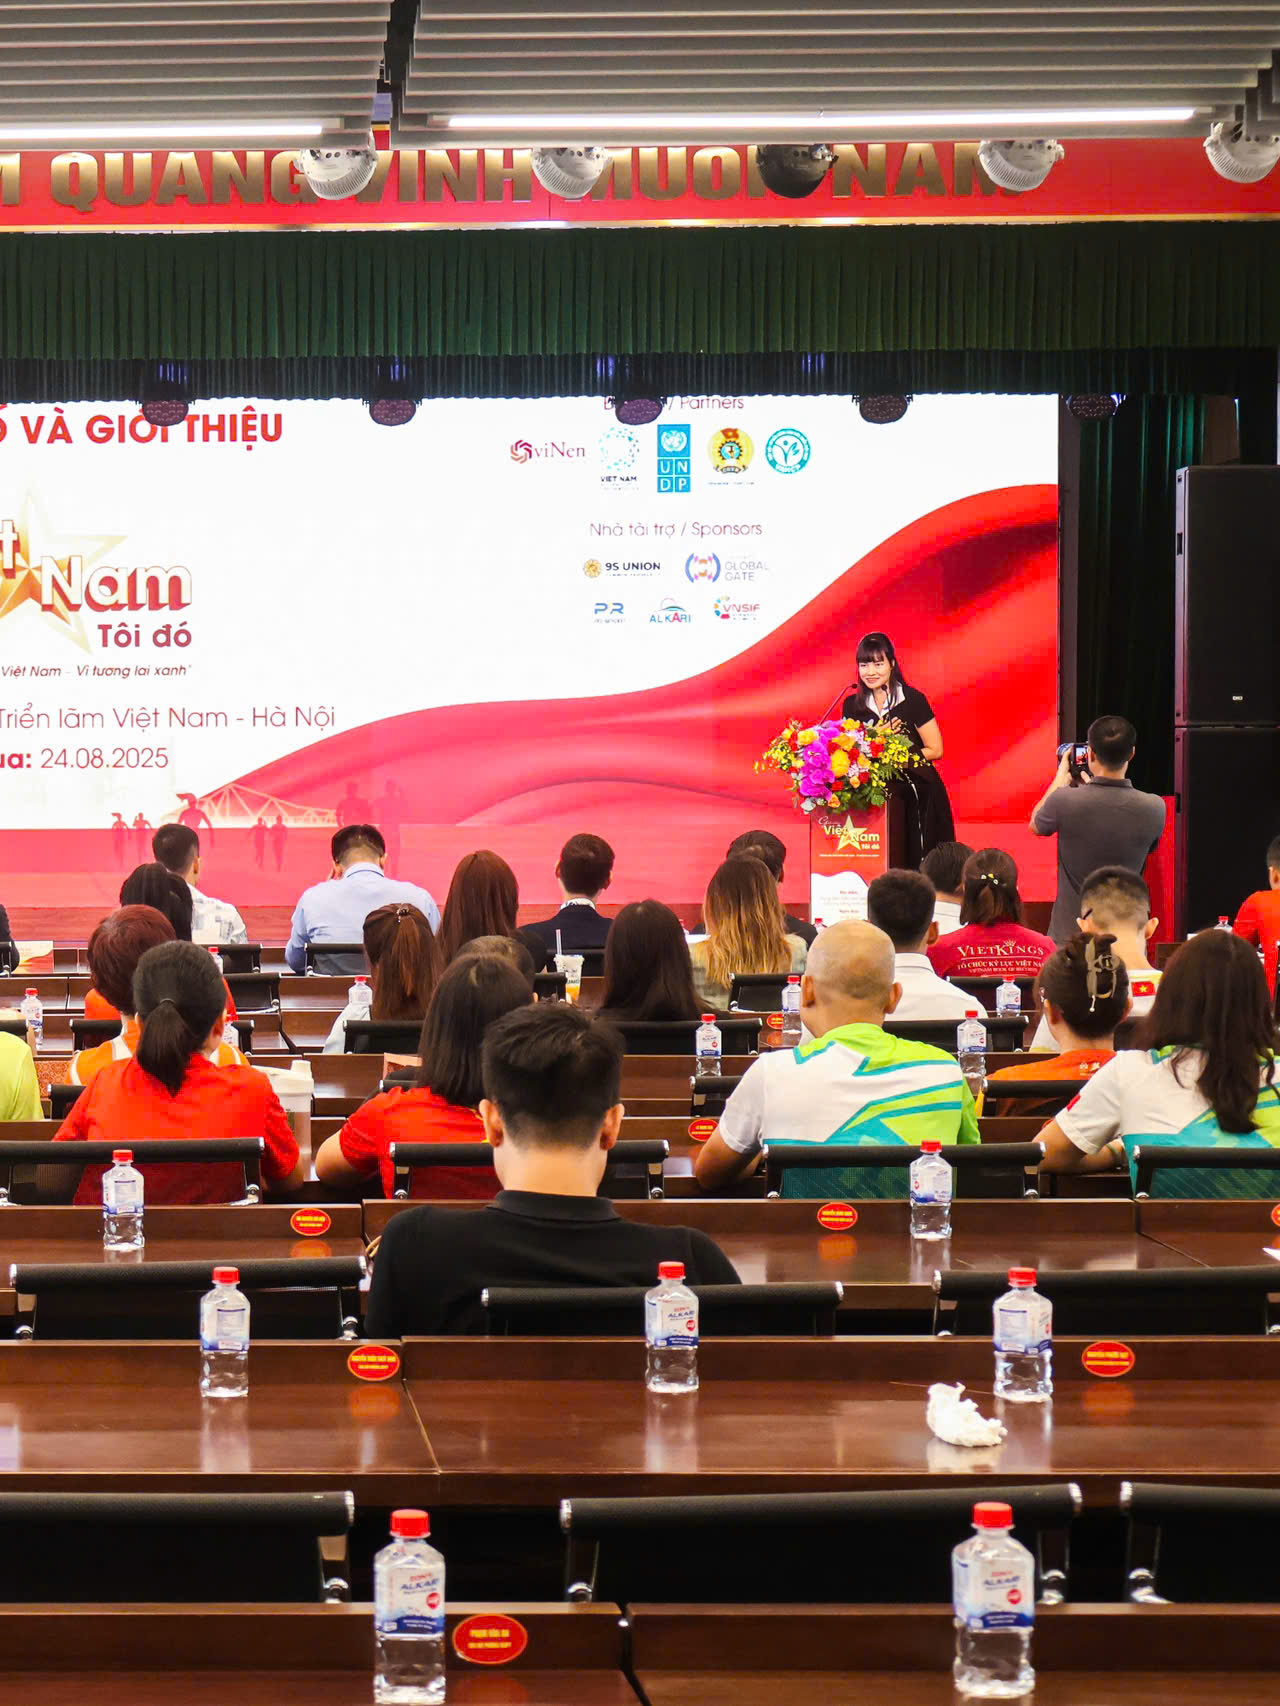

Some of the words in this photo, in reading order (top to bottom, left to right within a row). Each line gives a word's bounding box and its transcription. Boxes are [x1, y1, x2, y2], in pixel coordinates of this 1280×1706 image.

[50, 150, 319, 213] QUANG
[680, 396, 744, 409] Partners
[20, 406, 73, 444] VÀ
[185, 405, 282, 451] THIỆU
[535, 441, 585, 458] viNen
[590, 522, 623, 537] Nhà
[629, 523, 649, 537] tài
[654, 522, 676, 539] trợ
[691, 521, 763, 539] Sponsors
[623, 561, 661, 571] UNION
[724, 561, 769, 571] GLOBAL
[40, 555, 192, 612] Nam
[724, 571, 755, 581] GATE
[98, 622, 141, 648] Tôi
[152, 621, 193, 648] đó
[1, 665, 27, 680] Việt
[30, 665, 62, 677] Nam
[134, 665, 150, 677] lai
[59, 707, 104, 729] lãm
[112, 707, 160, 732] Việt
[169, 707, 228, 728] Nam
[252, 706, 286, 728] Hà
[295, 705, 335, 731] Nội
[40, 747, 169, 769] 24.08.2025
